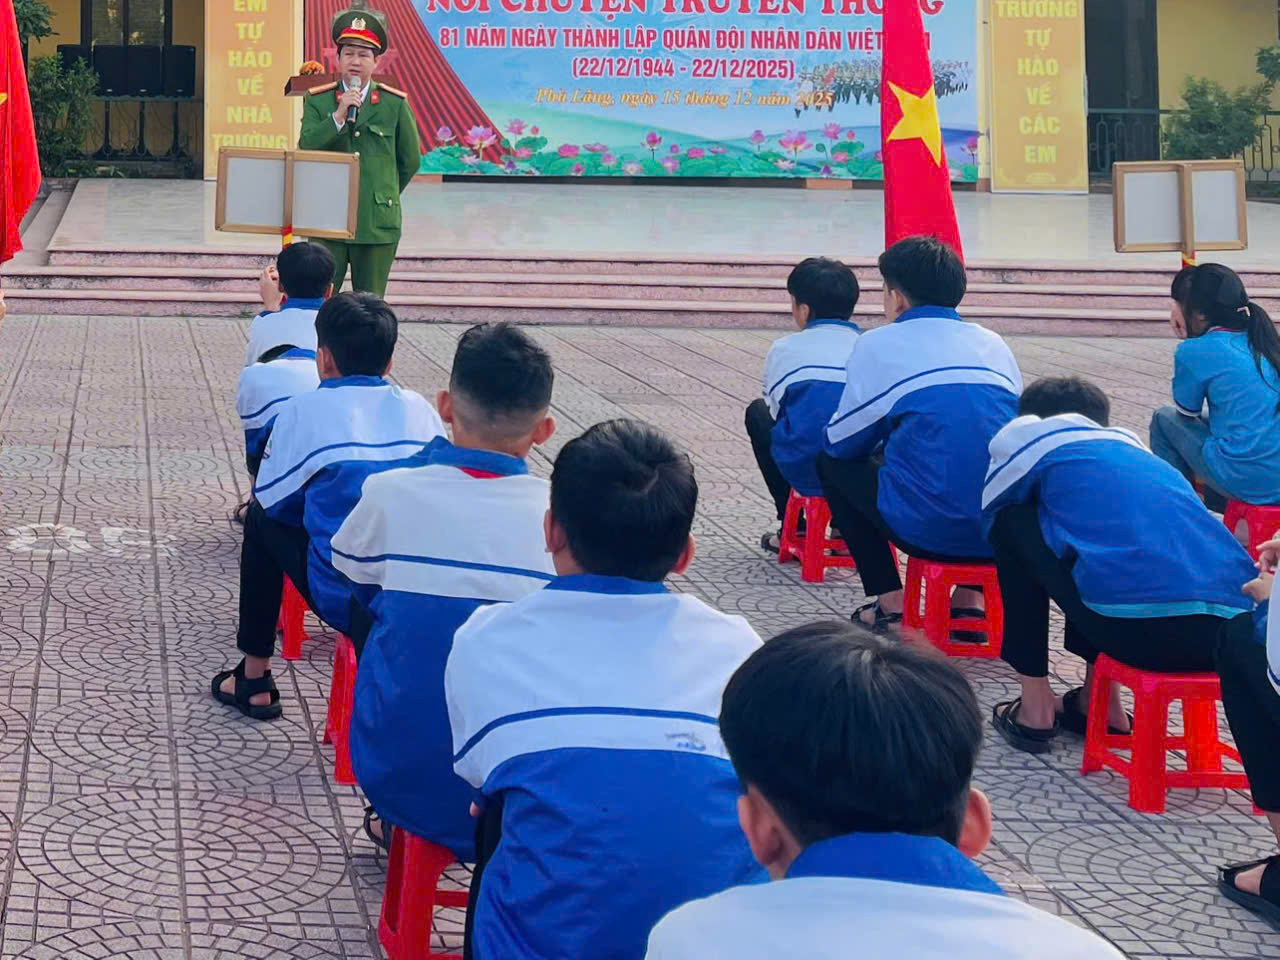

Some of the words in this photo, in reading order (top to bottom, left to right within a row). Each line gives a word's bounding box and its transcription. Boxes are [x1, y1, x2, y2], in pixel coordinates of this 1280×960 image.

[235, 21, 265, 43] TỰ
[440, 28, 458, 47] 81
[465, 25, 505, 47] NĂM
[511, 24, 557, 48] NGÀY
[563, 25, 618, 48] THÀNH
[624, 25, 657, 52] LẬP
[663, 25, 710, 50] QUÂN
[716, 25, 744, 53] ĐỘI
[751, 26, 800, 49] NHÂN
[805, 26, 841, 50] DÂN
[1024, 28, 1052, 50] TỰ
[227, 47, 272, 68] HÀO
[572, 57, 674, 79] (22/12/1944
[692, 58, 795, 80] 22/12/2025)
[1017, 54, 1059, 76] HÀO
[663, 90, 680, 105] 15
[685, 89, 729, 107] tháng
[734, 90, 752, 105] 12
[757, 90, 791, 105] năm
[226, 103, 272, 124] NHÀ
[1018, 112, 1061, 135] CÁC
[1024, 144, 1057, 164] EM
